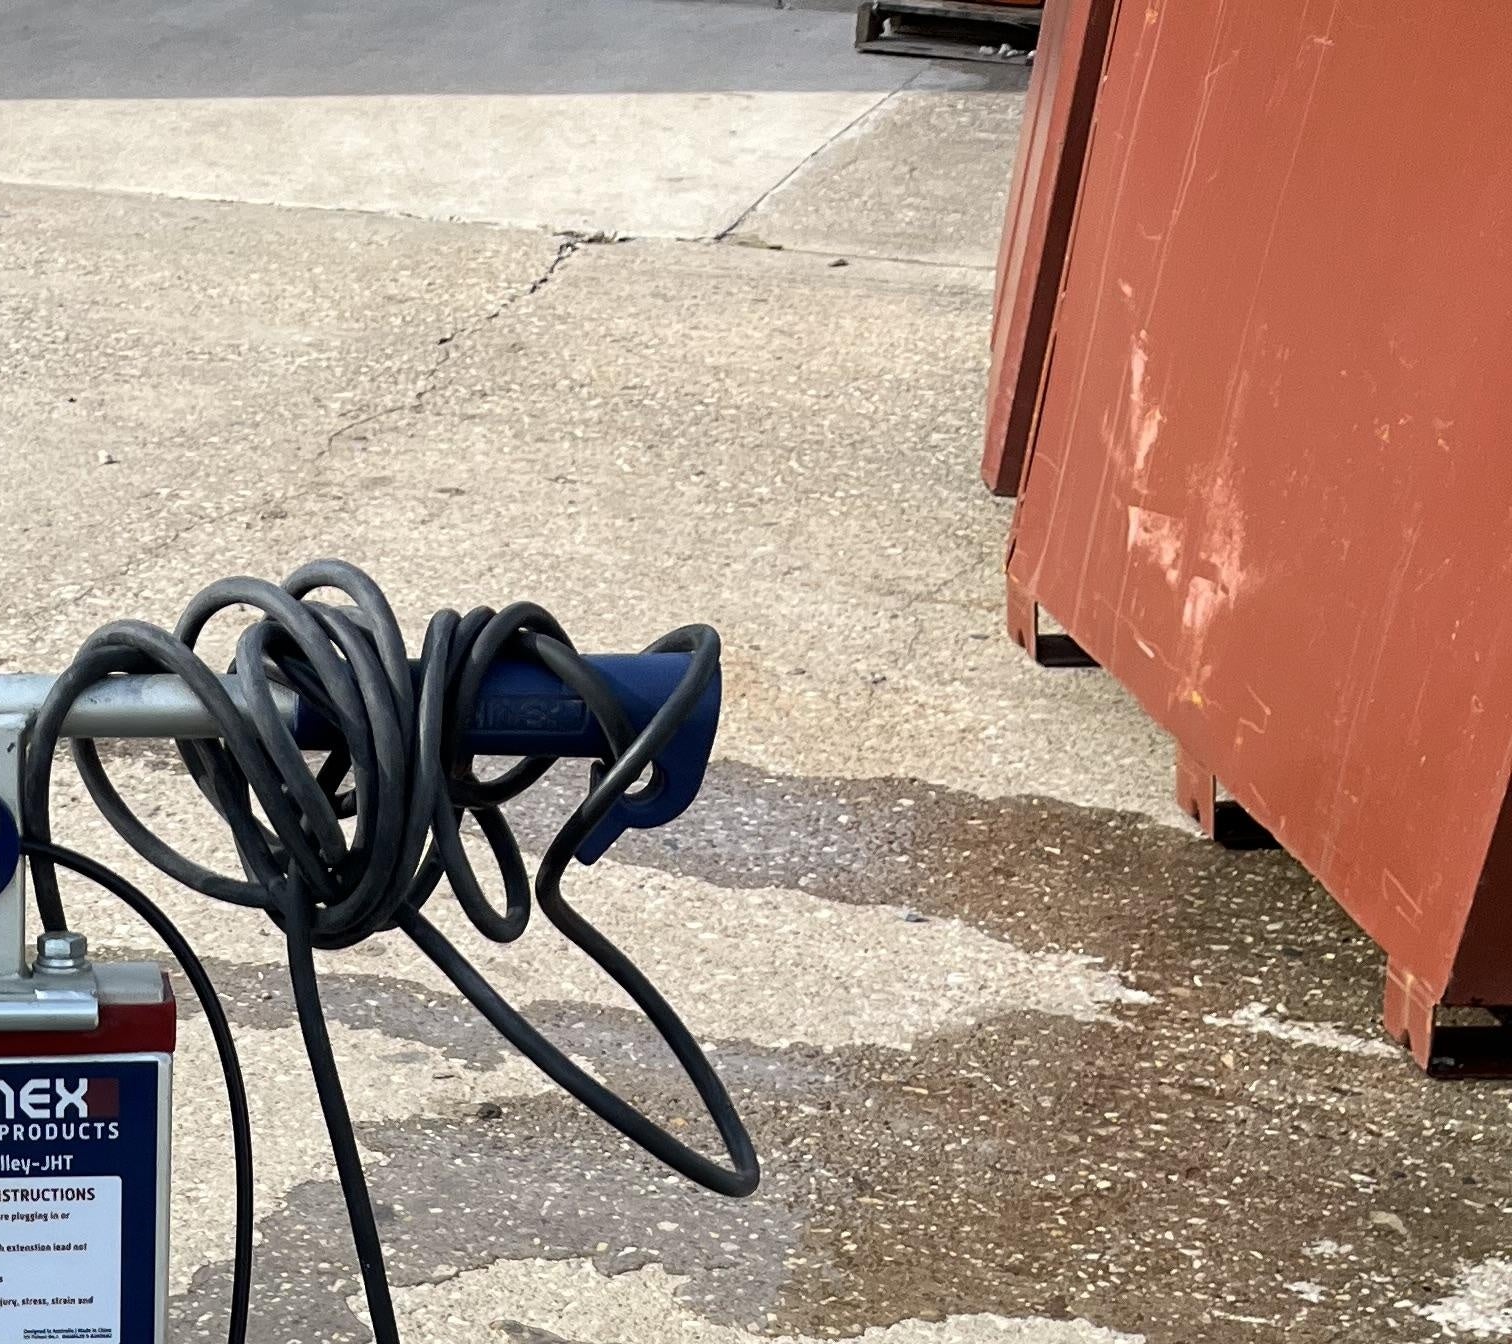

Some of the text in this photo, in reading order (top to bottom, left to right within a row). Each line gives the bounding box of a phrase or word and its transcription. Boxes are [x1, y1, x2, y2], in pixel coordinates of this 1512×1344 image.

[11, 1211, 49, 1222] plugging
[50, 1210, 59, 1219] in
[61, 1211, 71, 1219] or
[53, 1241, 72, 1251] lead
[73, 1242, 88, 1251] not
[21, 1296, 49, 1306] stress,
[50, 1295, 76, 1305] strain
[77, 1295, 94, 1305] and
